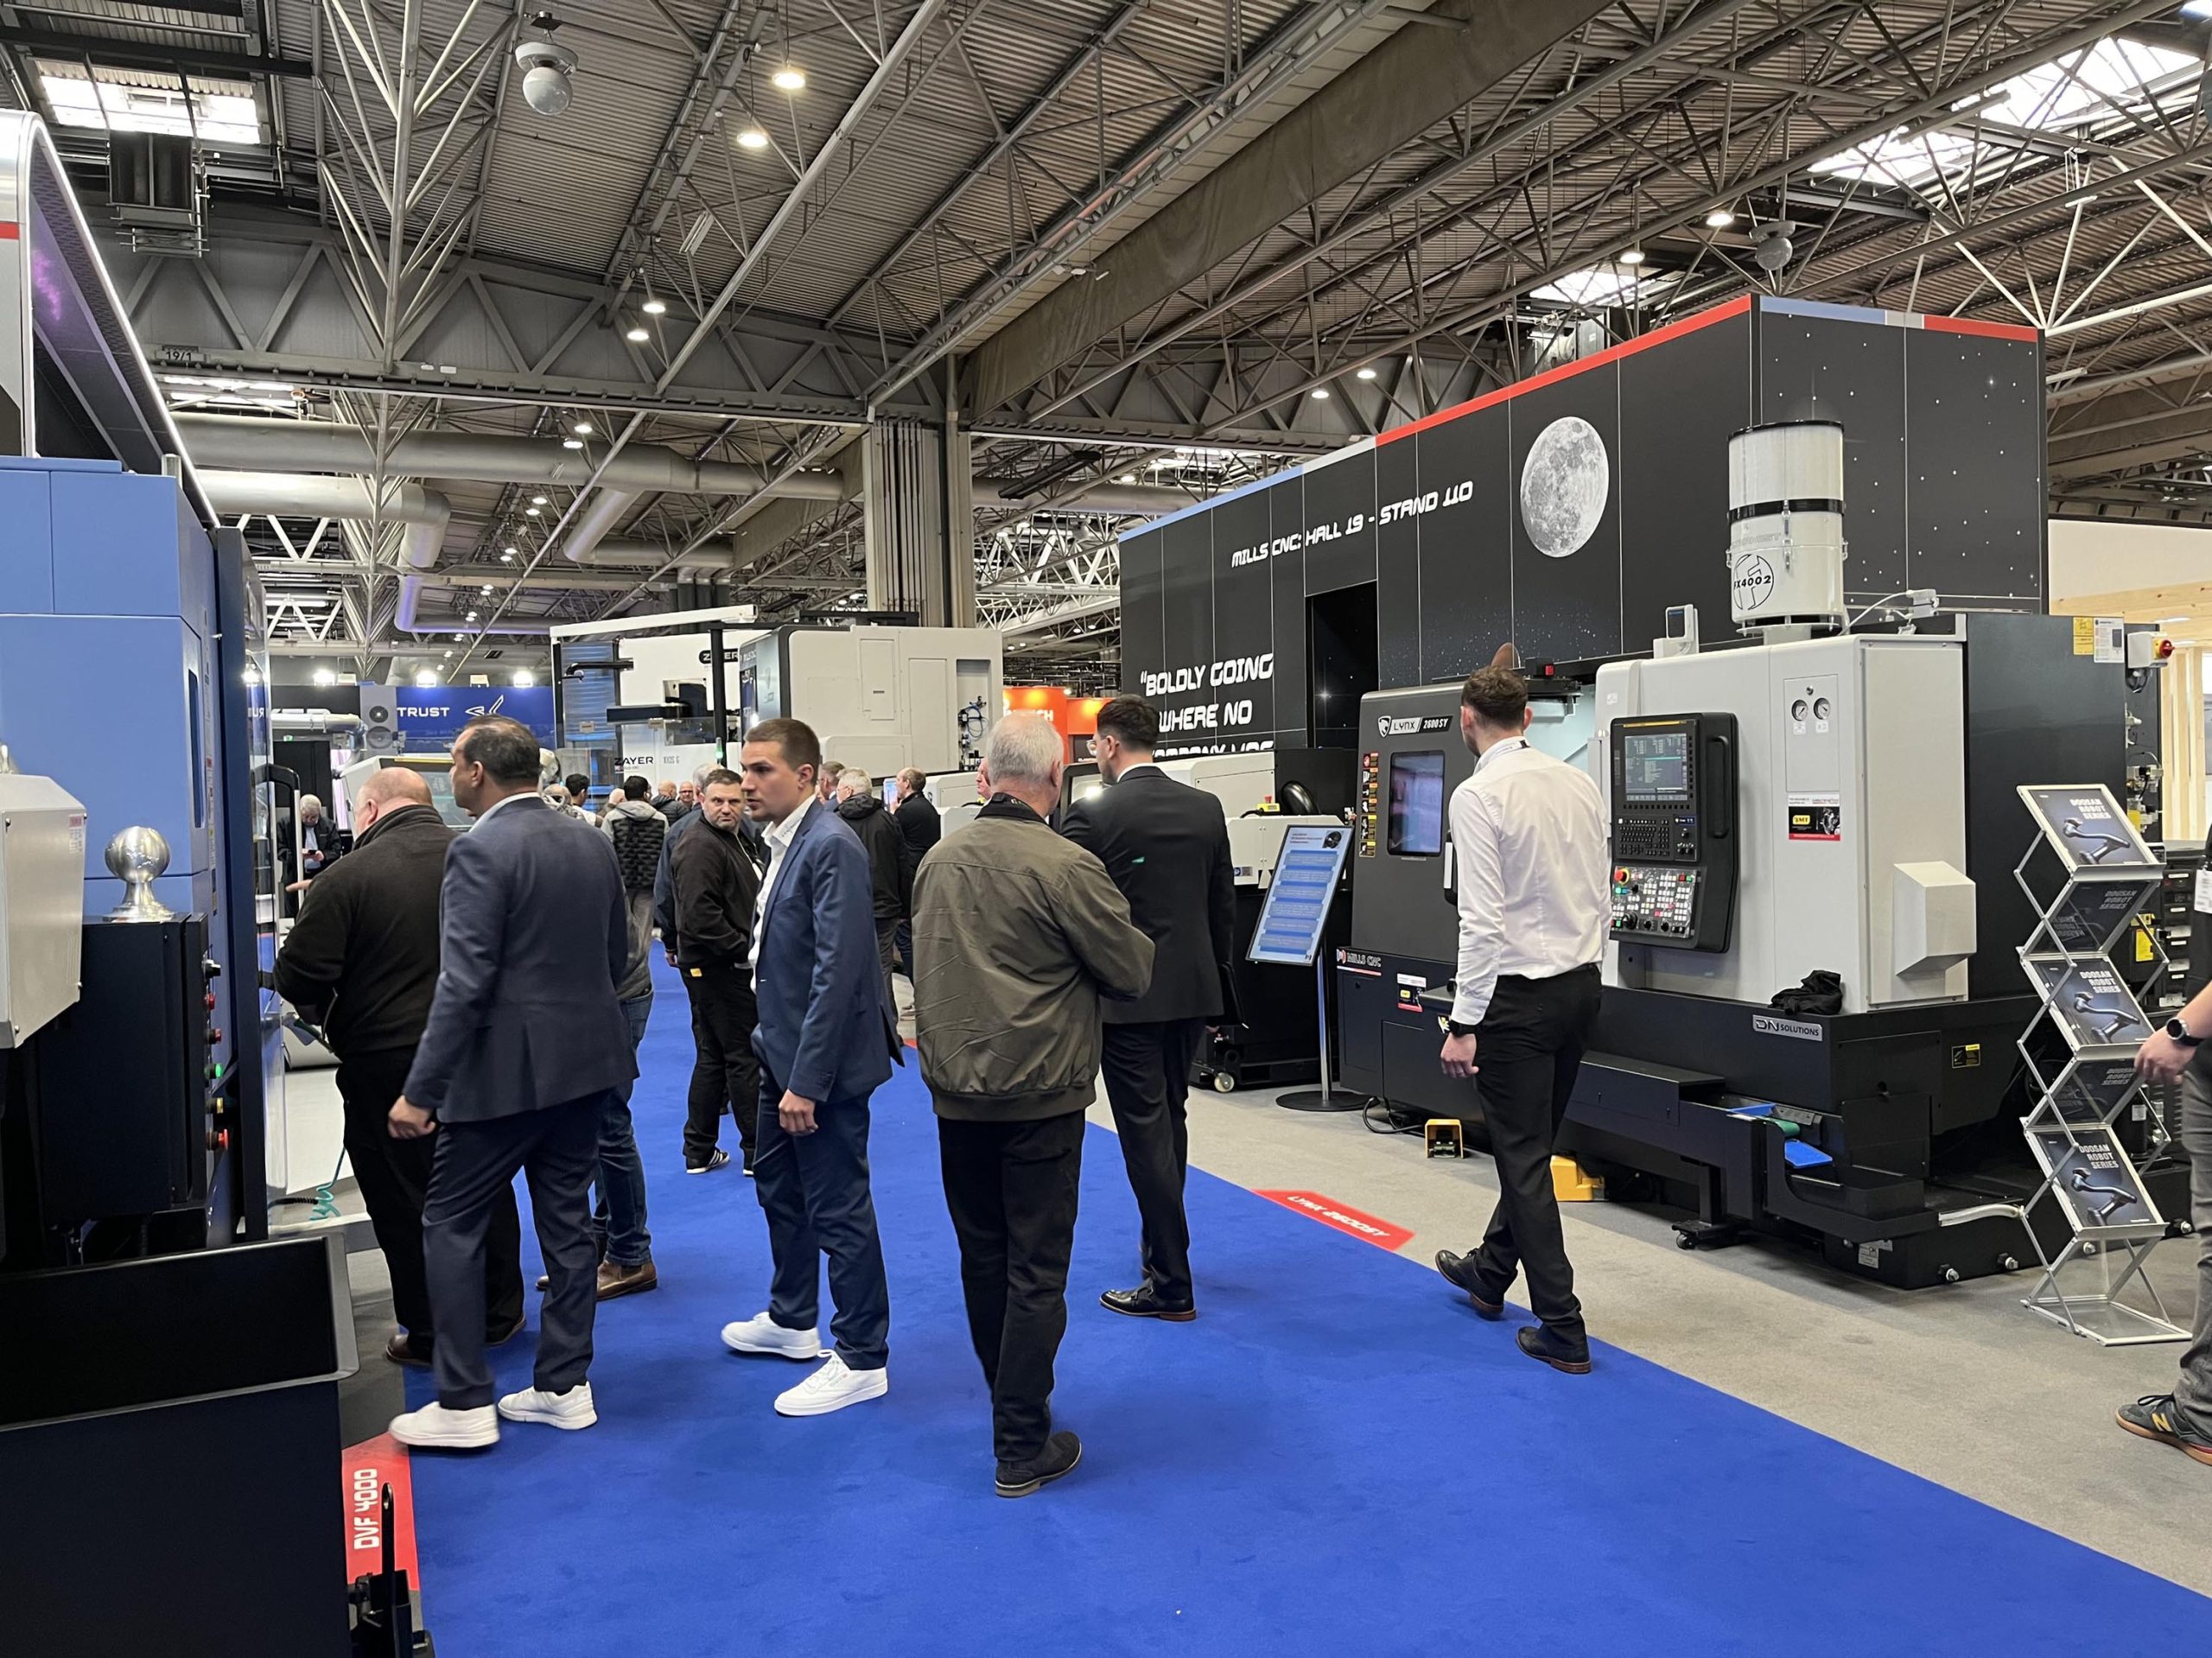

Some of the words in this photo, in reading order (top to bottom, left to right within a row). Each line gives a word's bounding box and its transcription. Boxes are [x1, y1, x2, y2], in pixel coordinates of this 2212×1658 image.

[166, 351, 192, 361] 19/1
[1231, 543, 1268, 568] MILLS
[1271, 533, 1302, 556] CNC:
[1306, 521, 1342, 546] HALL
[1345, 513, 1363, 535] 19
[1379, 491, 1439, 525] STAND
[1442, 480, 1473, 507] 110
[1210, 653, 1274, 687] GOING
[397, 707, 450, 717] TRUST
[1159, 703, 1219, 733] WHERE
[1224, 700, 1253, 726] NO
[613, 756, 654, 765] ZAYER
[2079, 970, 2113, 979] DOOSAN
[1780, 1024, 1819, 1037] SOLUTIONS
[2078, 1144, 2110, 1153] DOOSAN
[2087, 1152, 2113, 1161] ROBOT
[2090, 1160, 2119, 1169] SERIES
[353, 1468, 378, 1513] 4000
[353, 1516, 380, 1550] DVF
